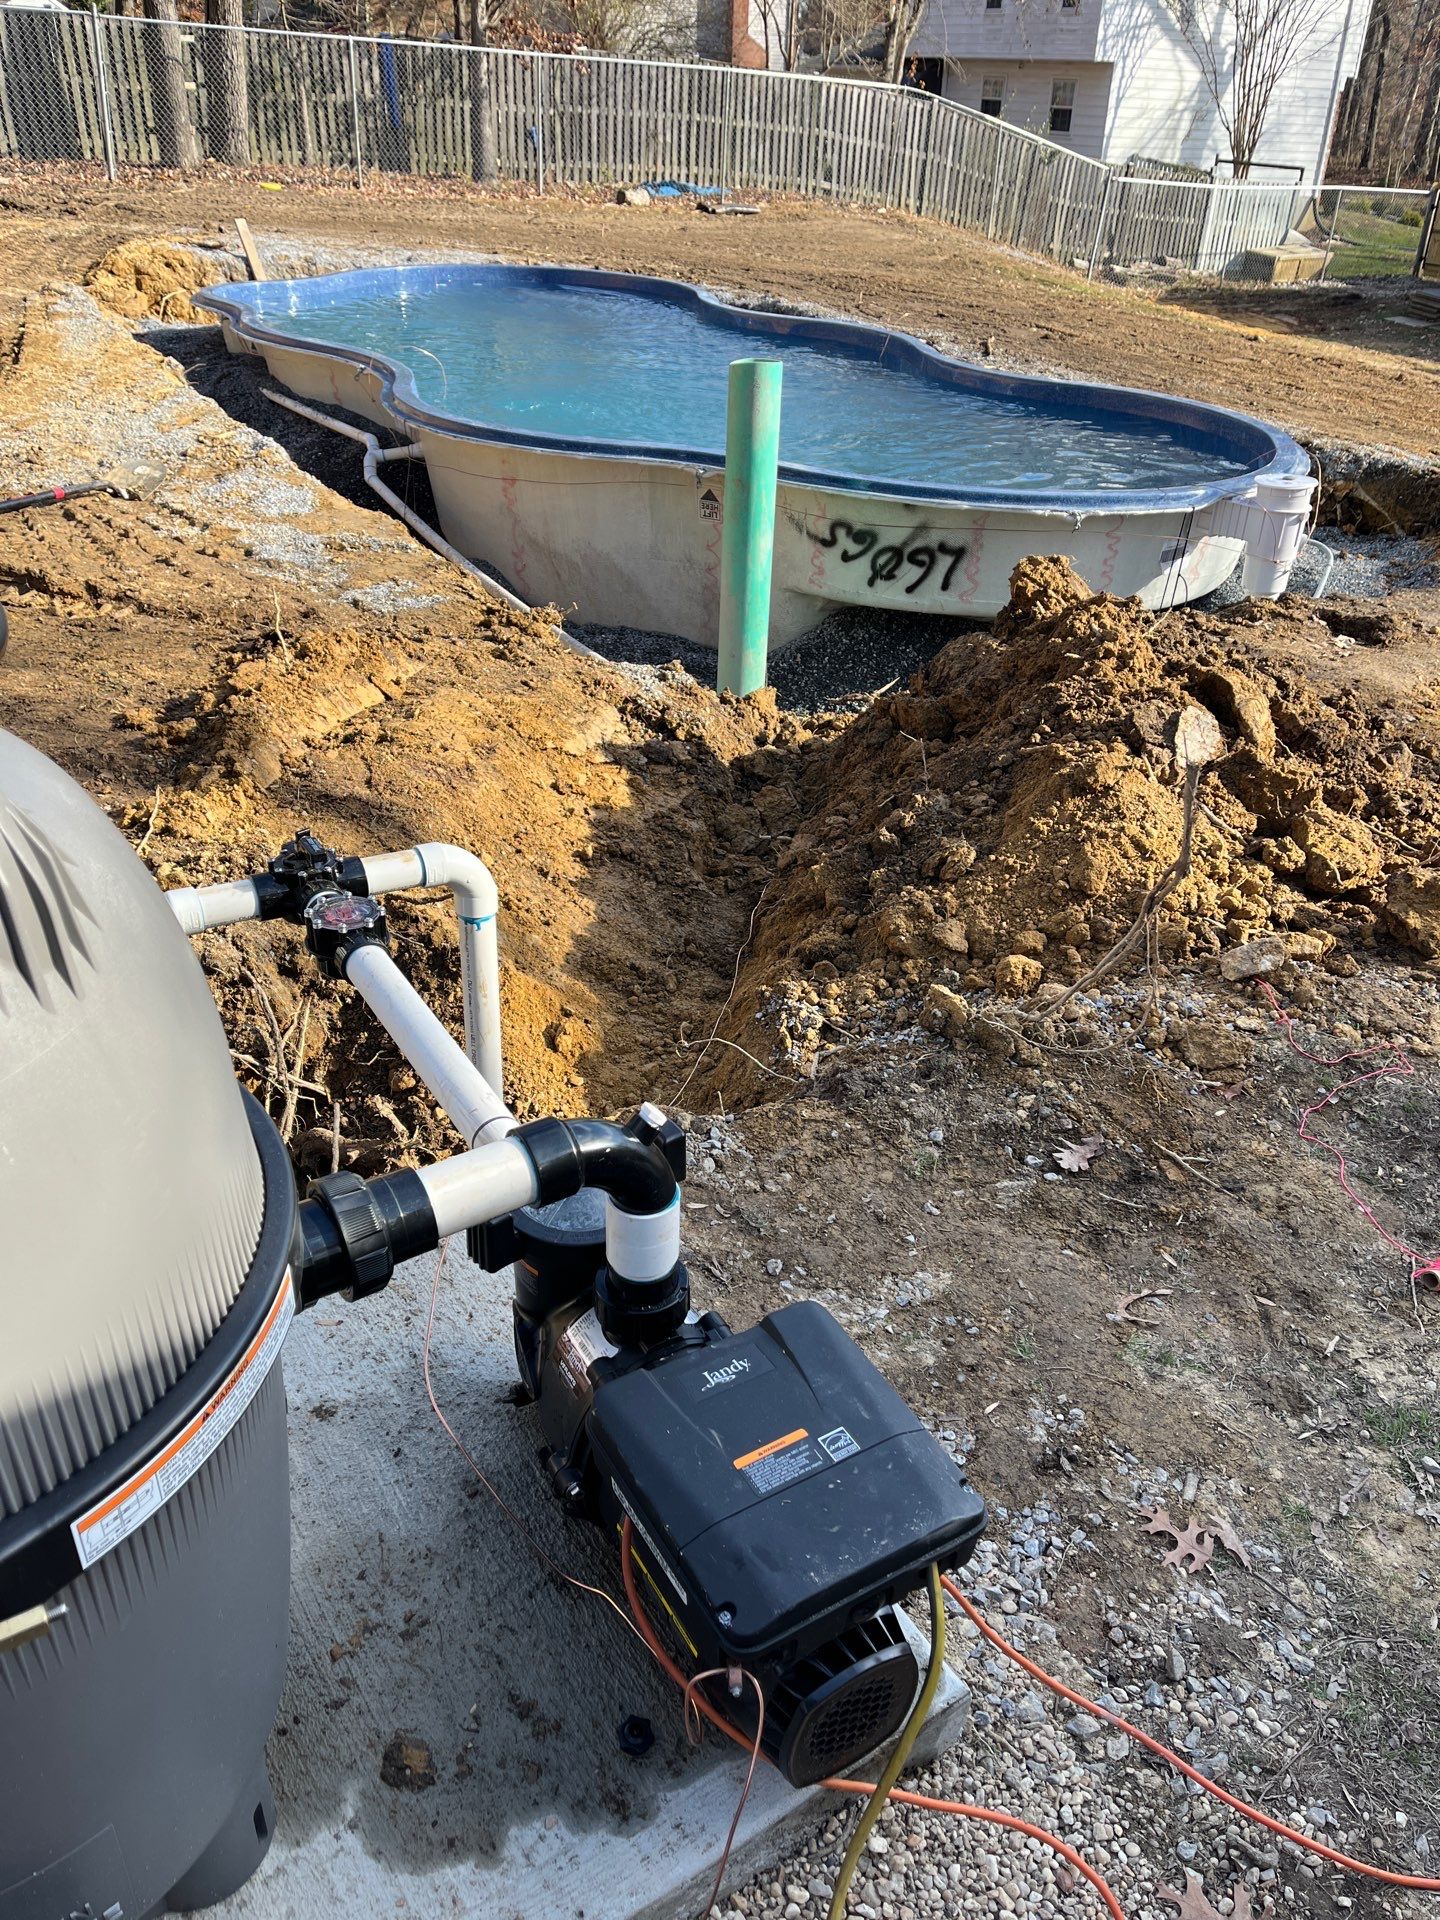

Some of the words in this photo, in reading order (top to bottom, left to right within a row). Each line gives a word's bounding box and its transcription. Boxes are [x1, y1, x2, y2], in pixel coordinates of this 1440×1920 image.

[701, 502, 719, 511] HERE
[702, 509, 718, 519] LIFT
[211, 1360, 249, 1409] WARNING
[701, 1358, 749, 1391] Jandy
